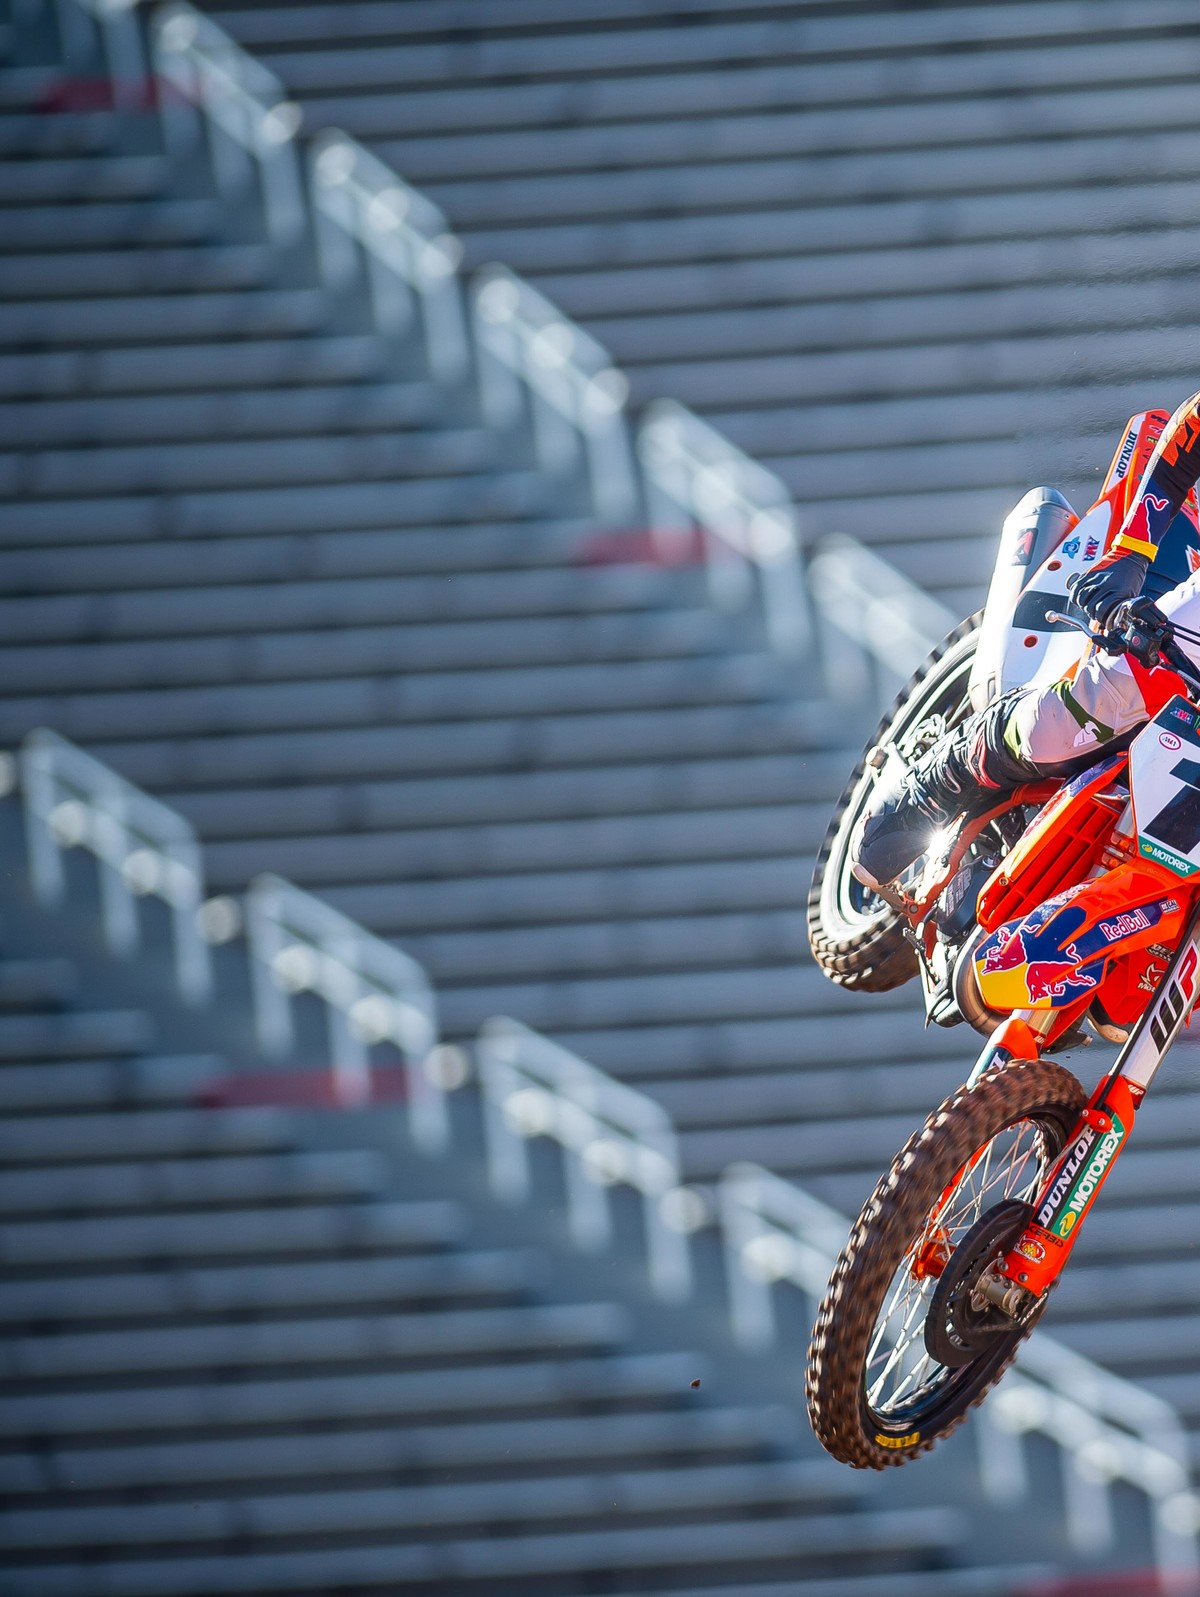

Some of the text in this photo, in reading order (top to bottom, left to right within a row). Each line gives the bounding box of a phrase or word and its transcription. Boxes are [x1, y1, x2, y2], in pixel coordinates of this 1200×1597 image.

[1116, 431, 1138, 478] DUNLOP
[1152, 847, 1191, 873] MOTOREX
[1069, 1127, 1125, 1213] MOTOREX
